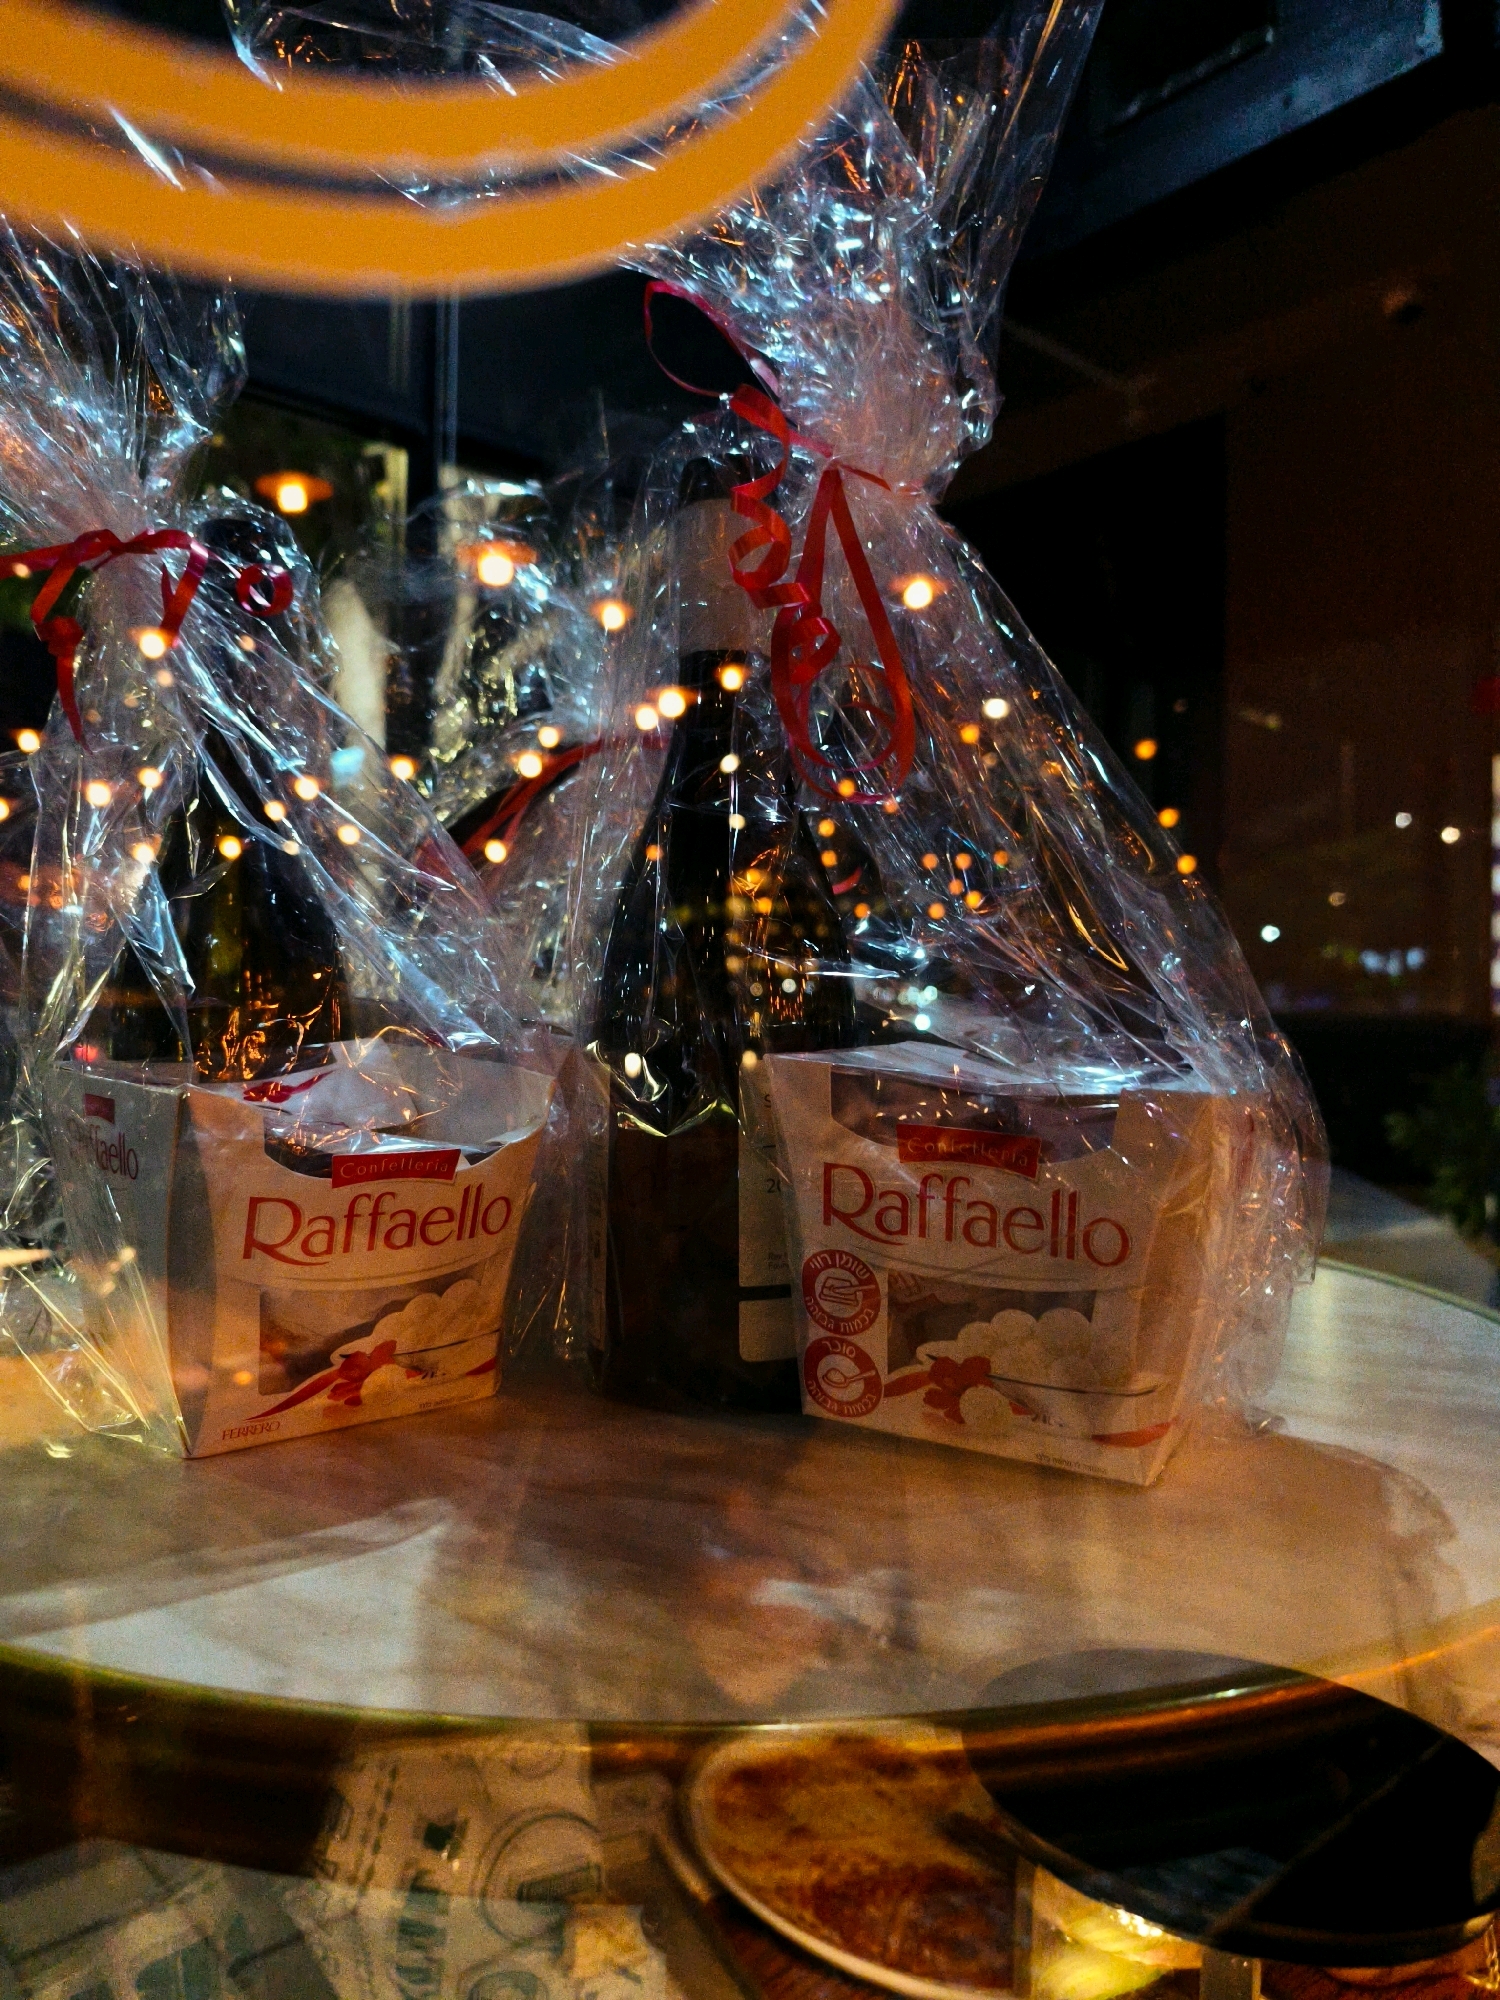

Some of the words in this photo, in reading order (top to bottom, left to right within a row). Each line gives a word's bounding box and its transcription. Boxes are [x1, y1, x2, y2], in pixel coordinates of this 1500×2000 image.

[340, 1157, 449, 1179] Confetteria
[242, 1183, 512, 1266] Raffaello
[822, 1162, 1131, 1267] Raffaello
[835, 1251, 871, 1280] שומן
[840, 1308, 875, 1333] בכמות
[821, 1339, 856, 1358] סוכר
[222, 1420, 281, 1440] FERRERO
